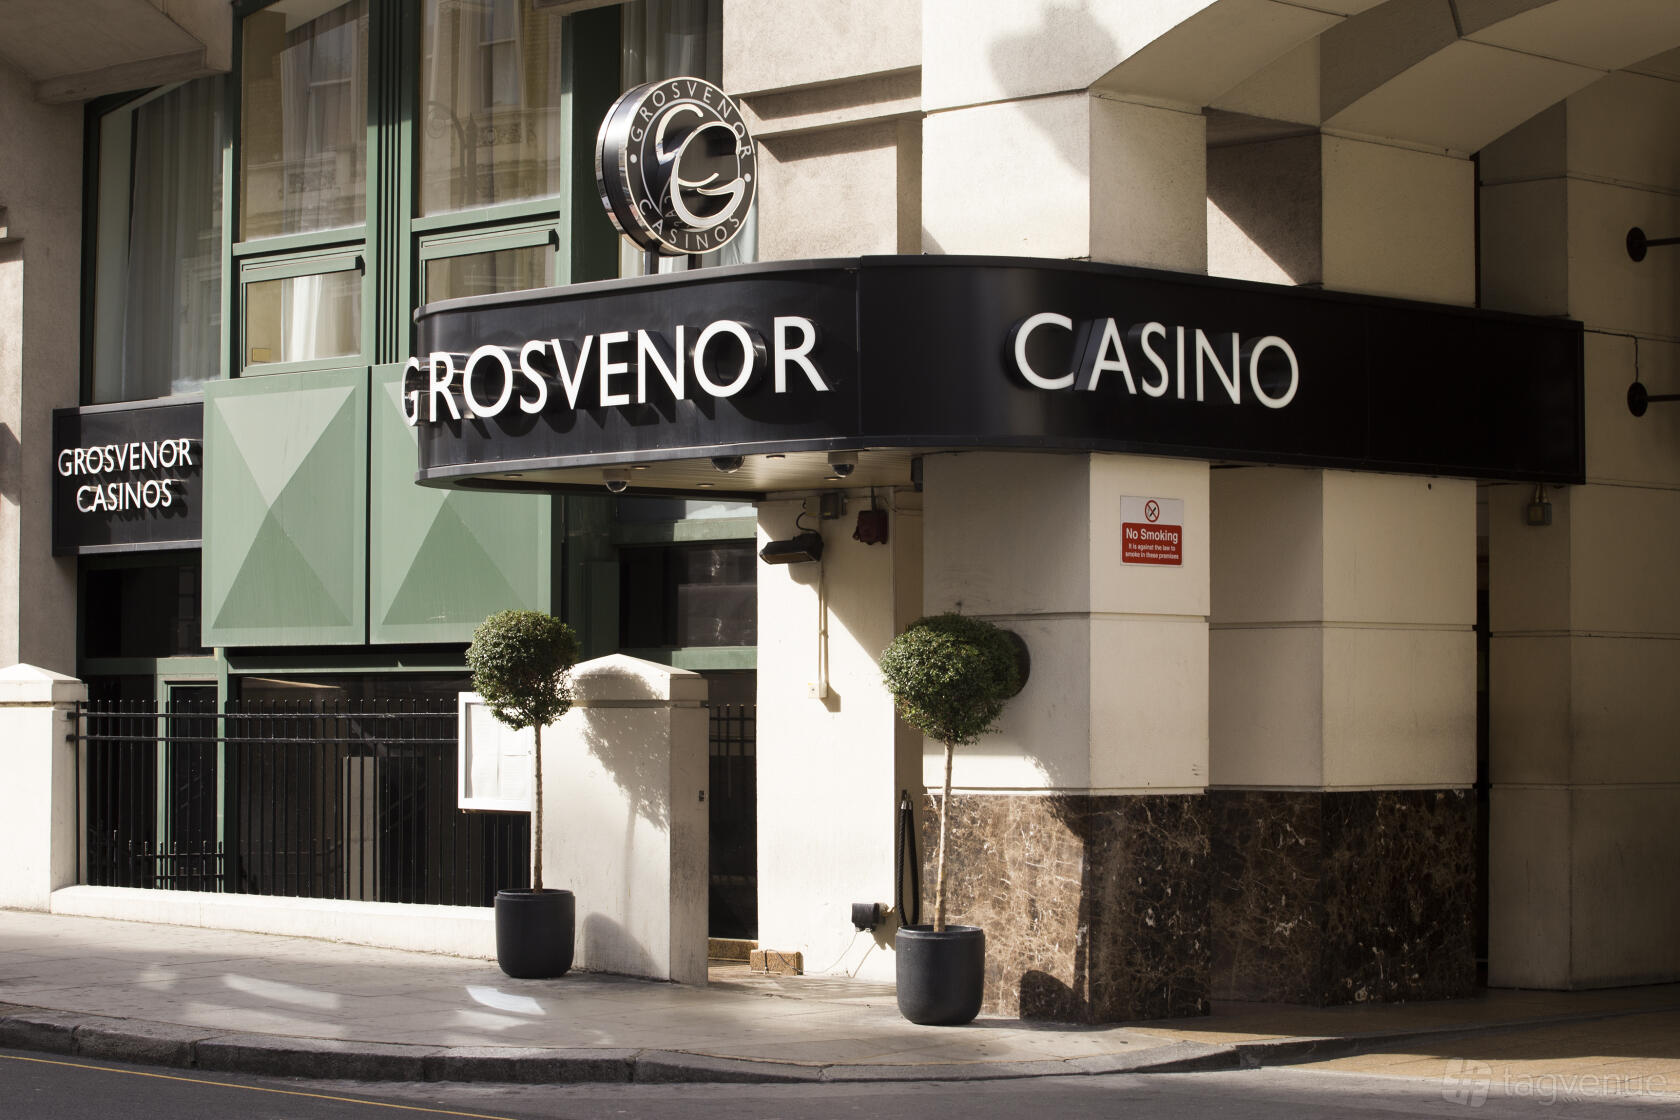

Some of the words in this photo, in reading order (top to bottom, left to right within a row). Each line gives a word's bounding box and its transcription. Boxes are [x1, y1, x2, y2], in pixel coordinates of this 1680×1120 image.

[631, 81, 751, 159] GROSVENOR
[639, 199, 740, 249] CASINOS
[402, 316, 829, 427] GROSVENOR
[1014, 312, 1299, 409] CASINO
[58, 438, 193, 477] GROSVENOR
[76, 479, 173, 513] CASINOS
[1126, 528, 1138, 539] No
[1141, 529, 1178, 544] Smoking
